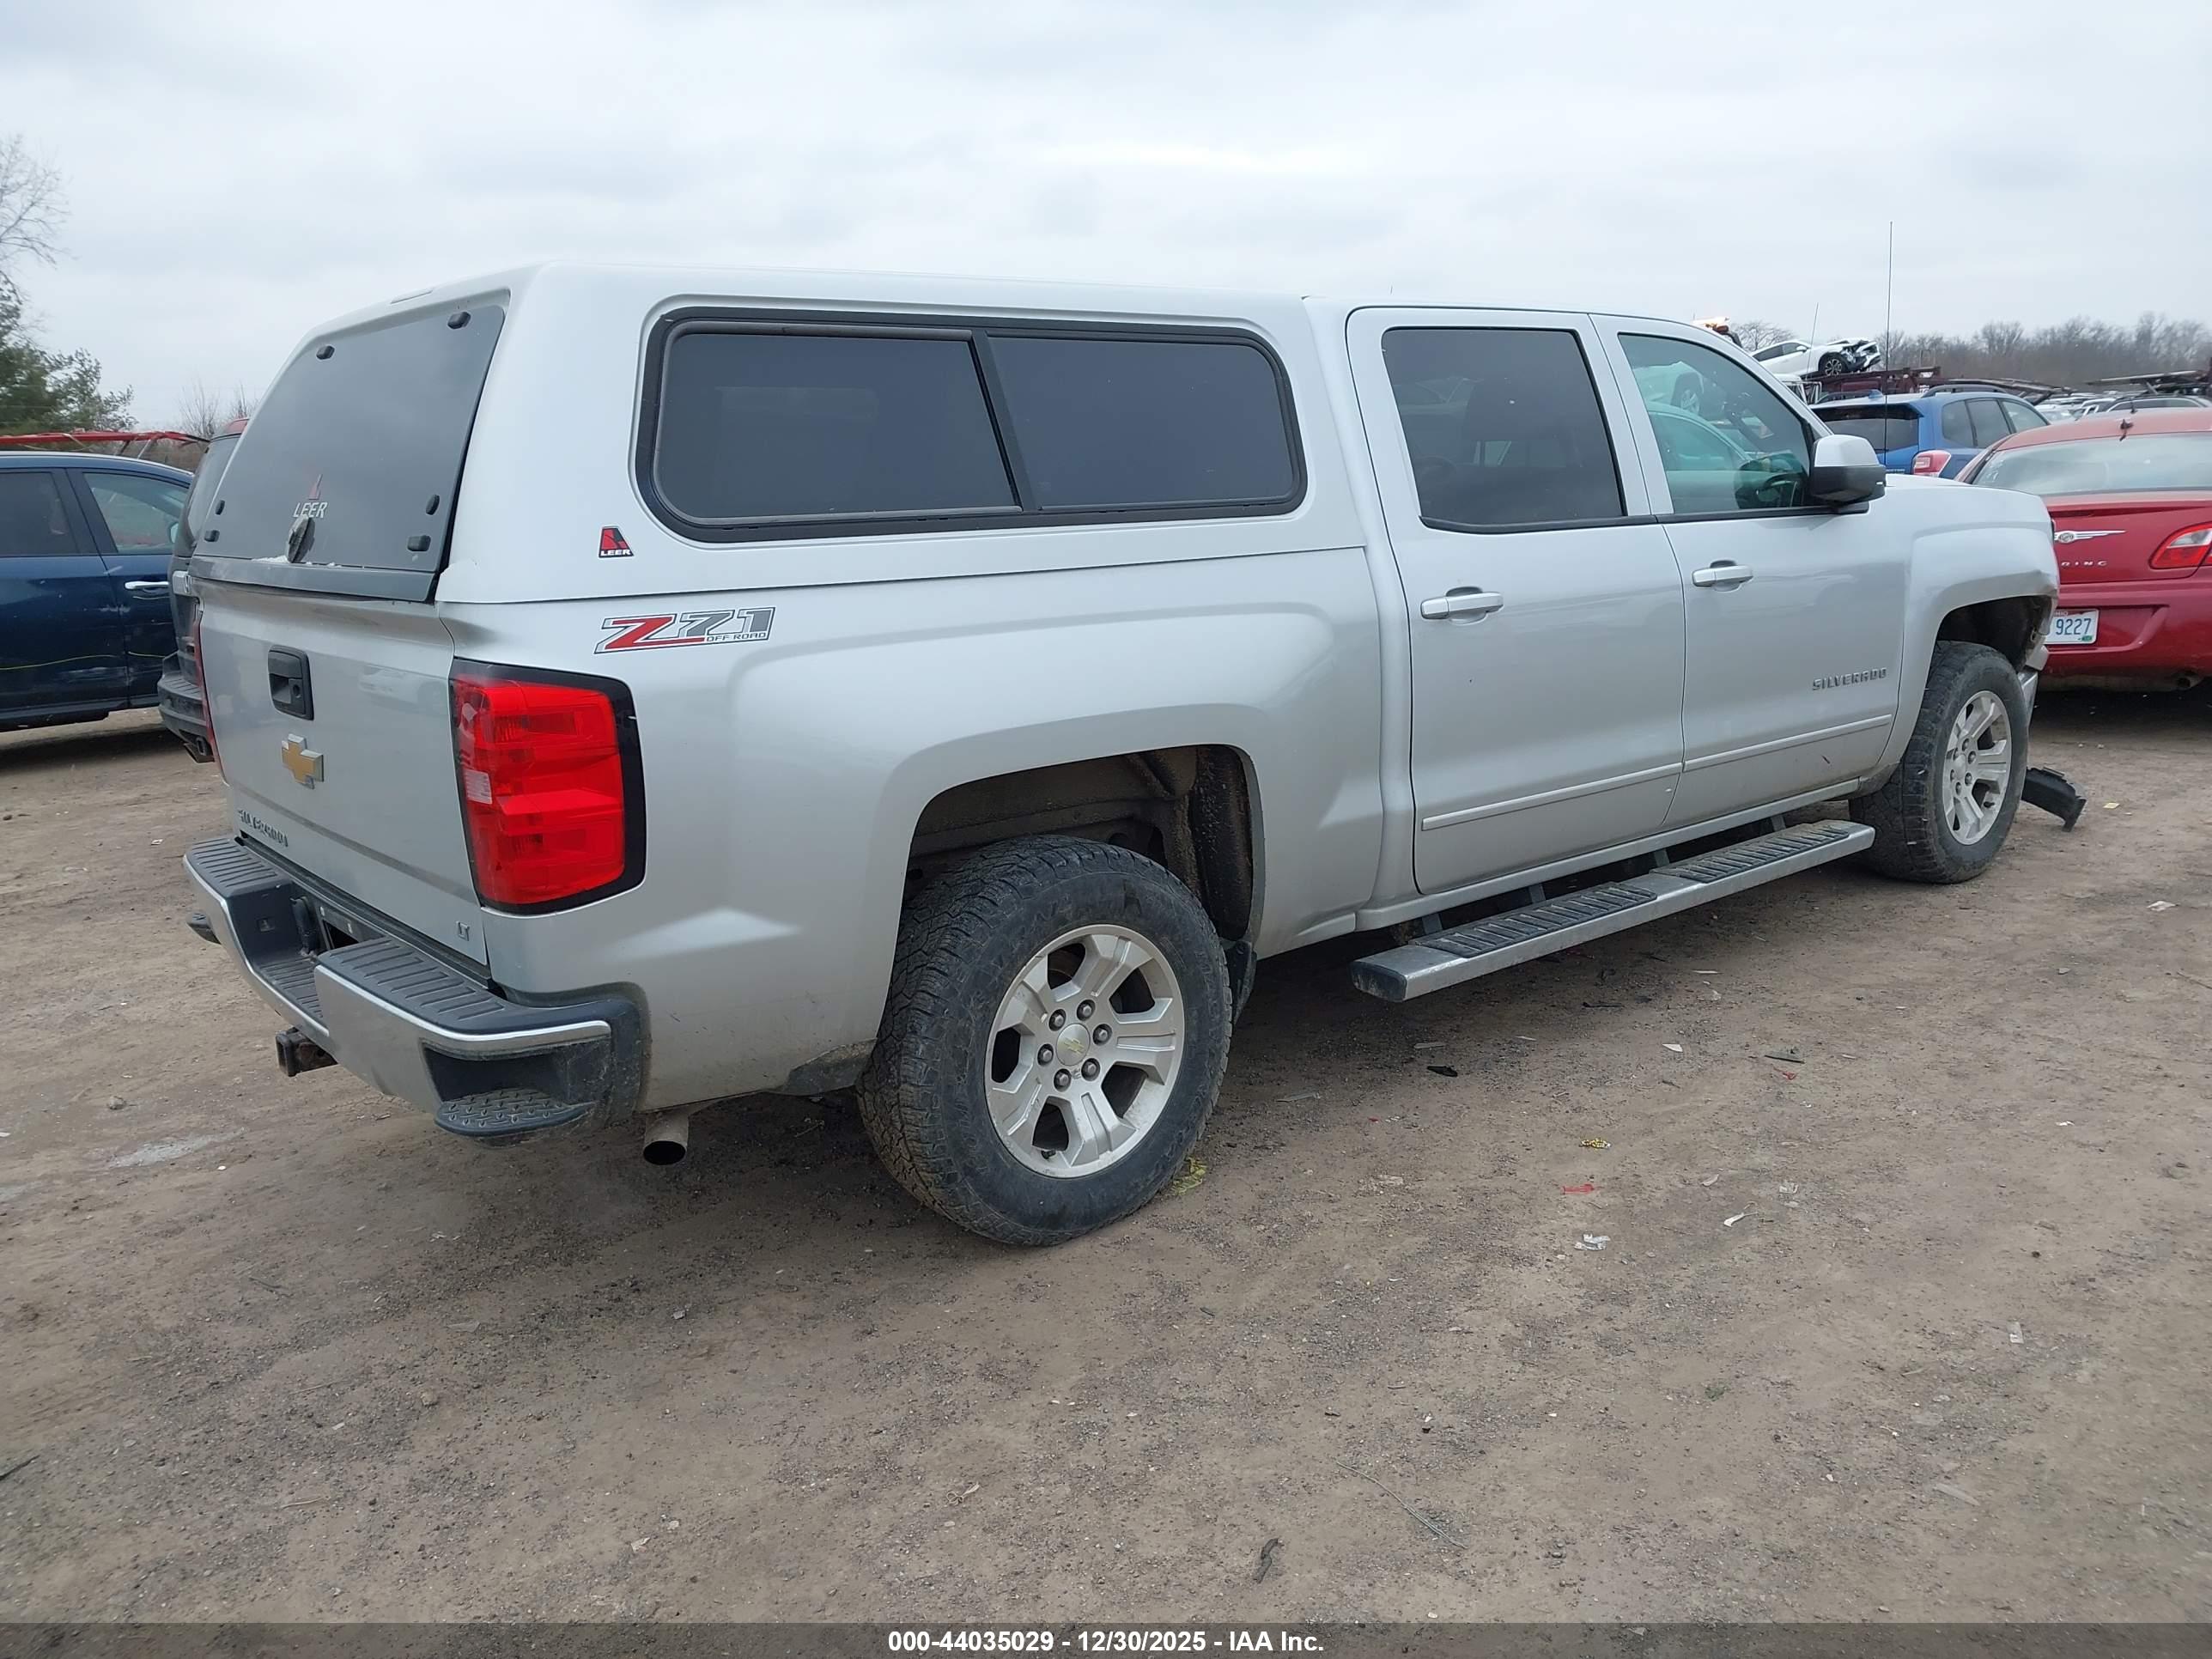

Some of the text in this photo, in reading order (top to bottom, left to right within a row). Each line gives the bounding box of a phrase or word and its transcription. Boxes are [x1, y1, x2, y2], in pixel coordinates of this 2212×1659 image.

[292, 501, 328, 519] LEER
[593, 606, 776, 654] Z71
[1812, 667, 1887, 691] SILVERADO
